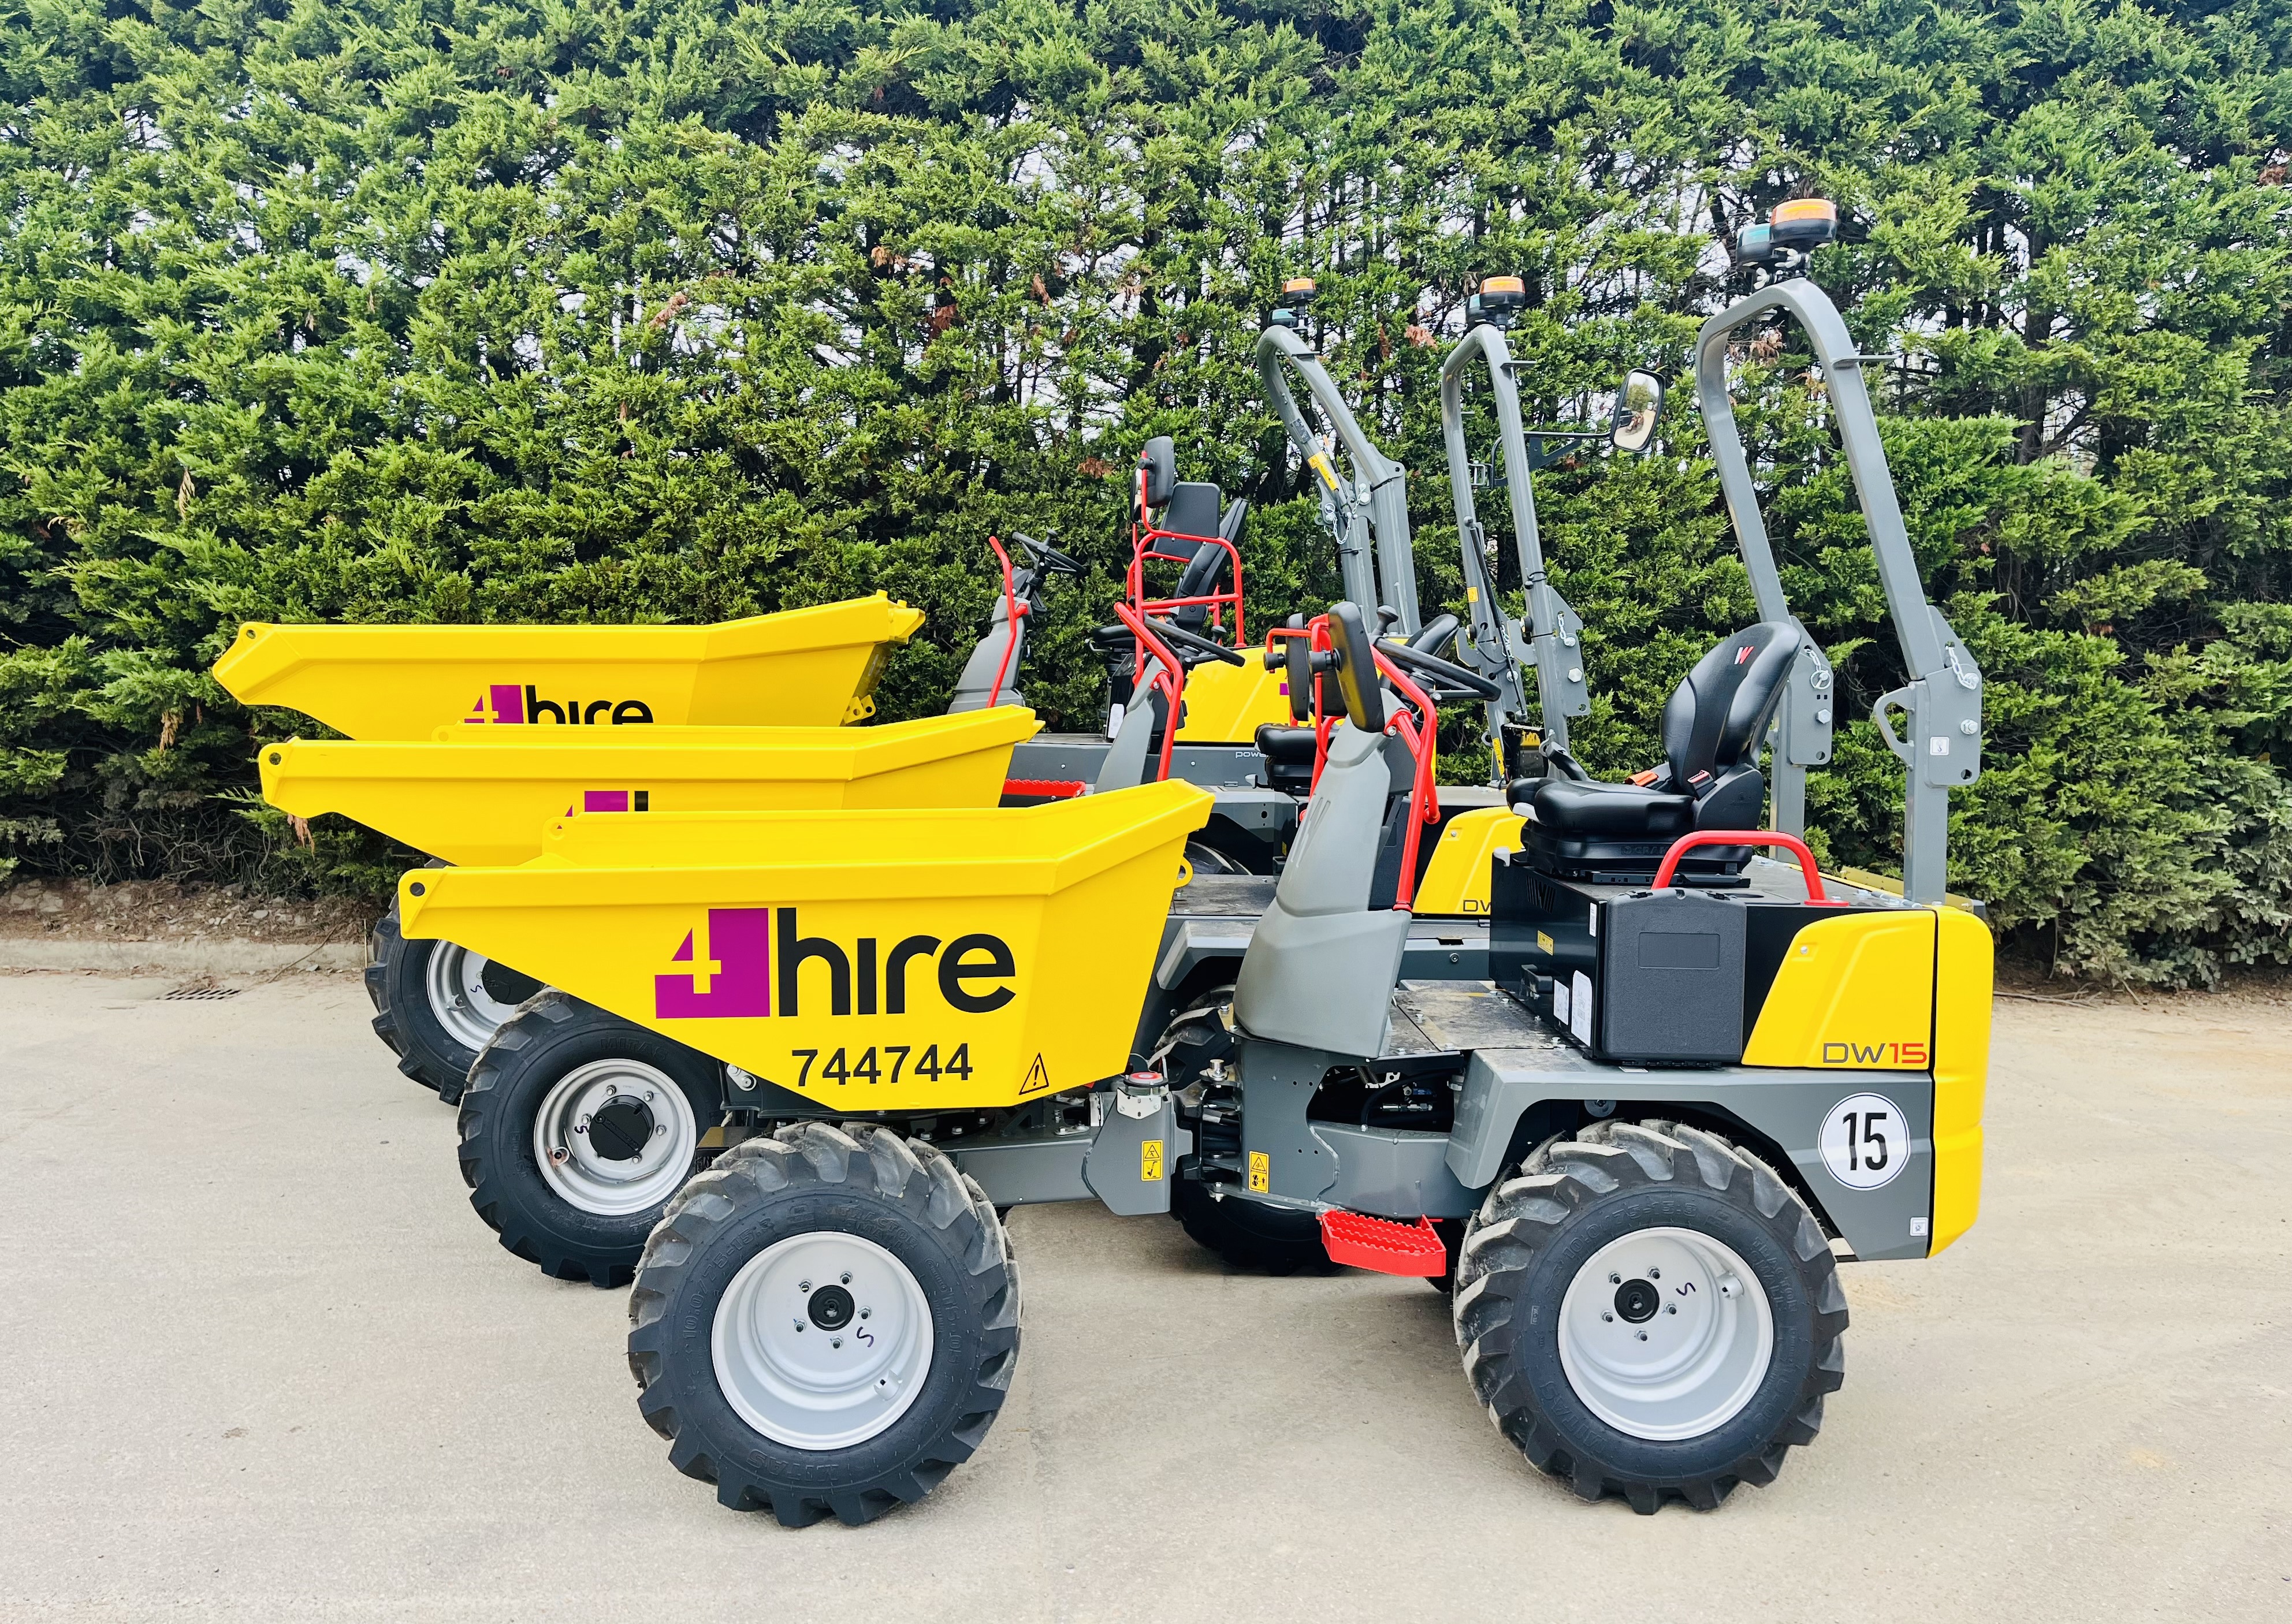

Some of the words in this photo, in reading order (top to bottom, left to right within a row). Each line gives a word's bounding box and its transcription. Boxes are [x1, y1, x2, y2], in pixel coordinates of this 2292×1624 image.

[791, 1043, 973, 1087] 744744
[1823, 1043, 1927, 1064] DW15
[1843, 1112, 1888, 1171] 15
